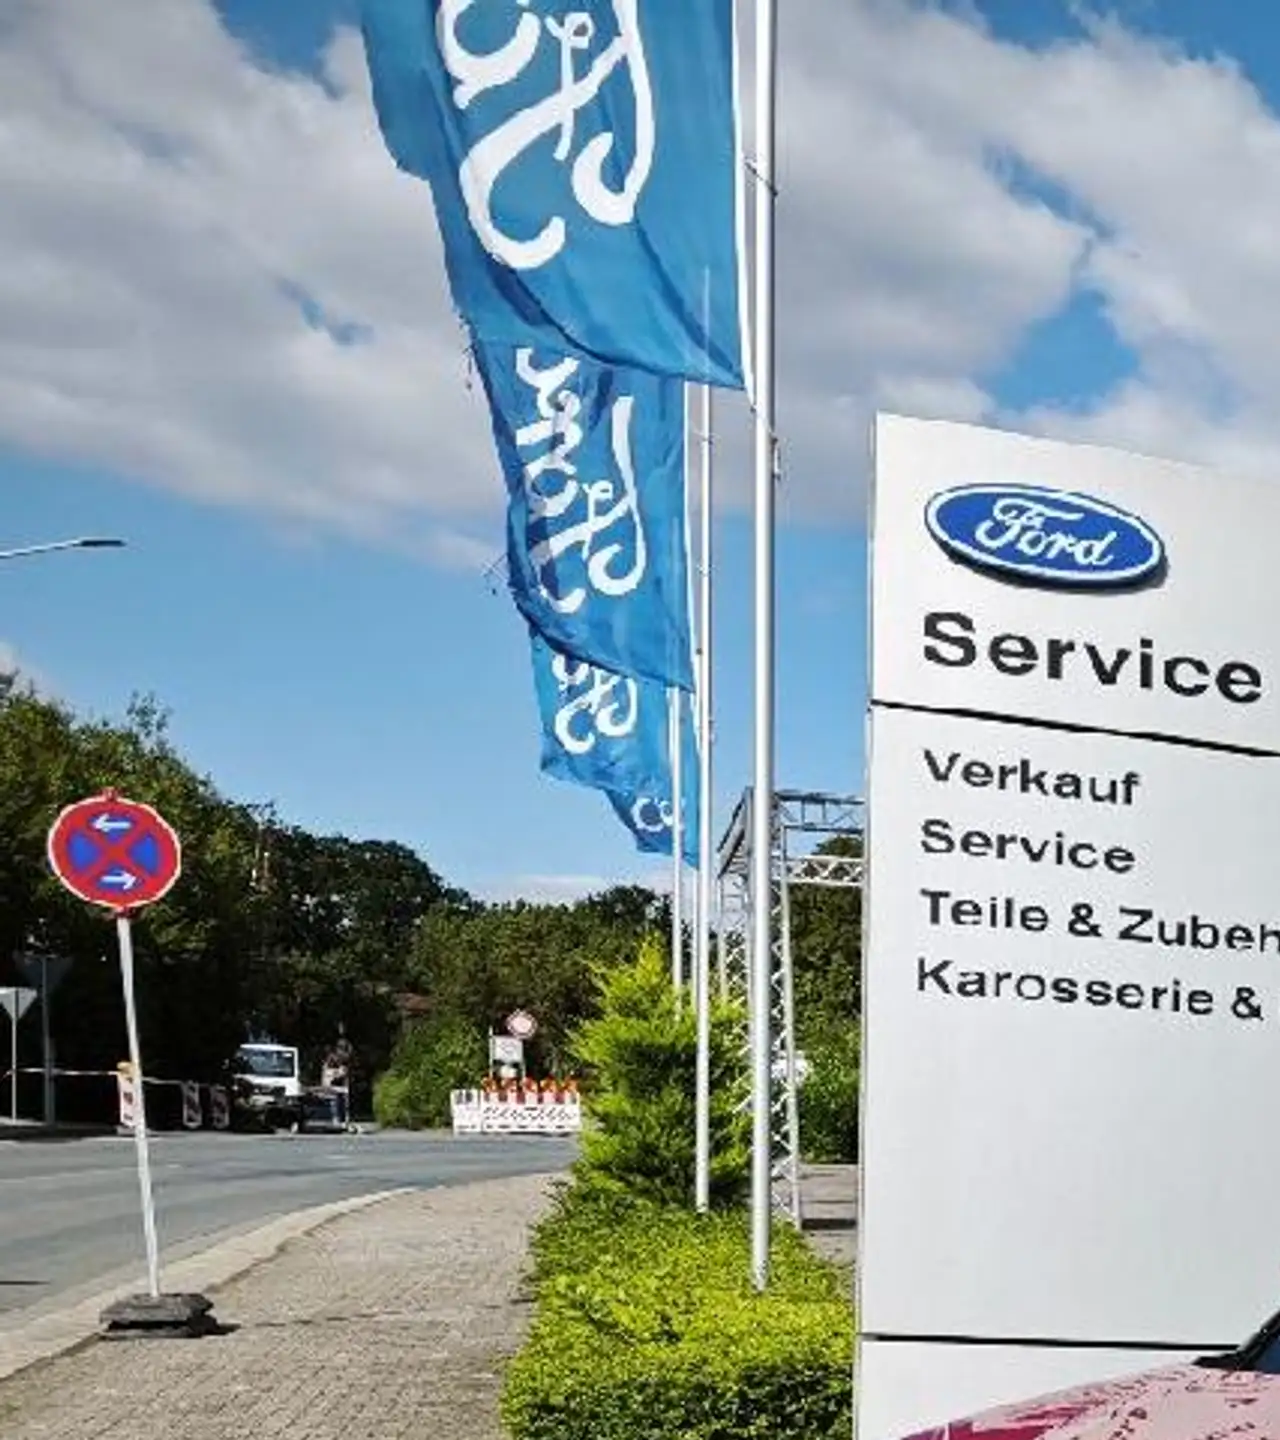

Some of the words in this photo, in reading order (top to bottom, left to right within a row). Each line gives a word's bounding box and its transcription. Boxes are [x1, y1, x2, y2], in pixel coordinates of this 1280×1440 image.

[975, 497, 1117, 566] Ford
[923, 611, 1264, 704] Service
[923, 748, 1141, 806] Verkauf
[920, 818, 1137, 875] Service
[919, 887, 1050, 933] Teile
[1067, 902, 1103, 938] &
[917, 956, 1215, 1016] Karosserie
[1230, 986, 1265, 1021] &
